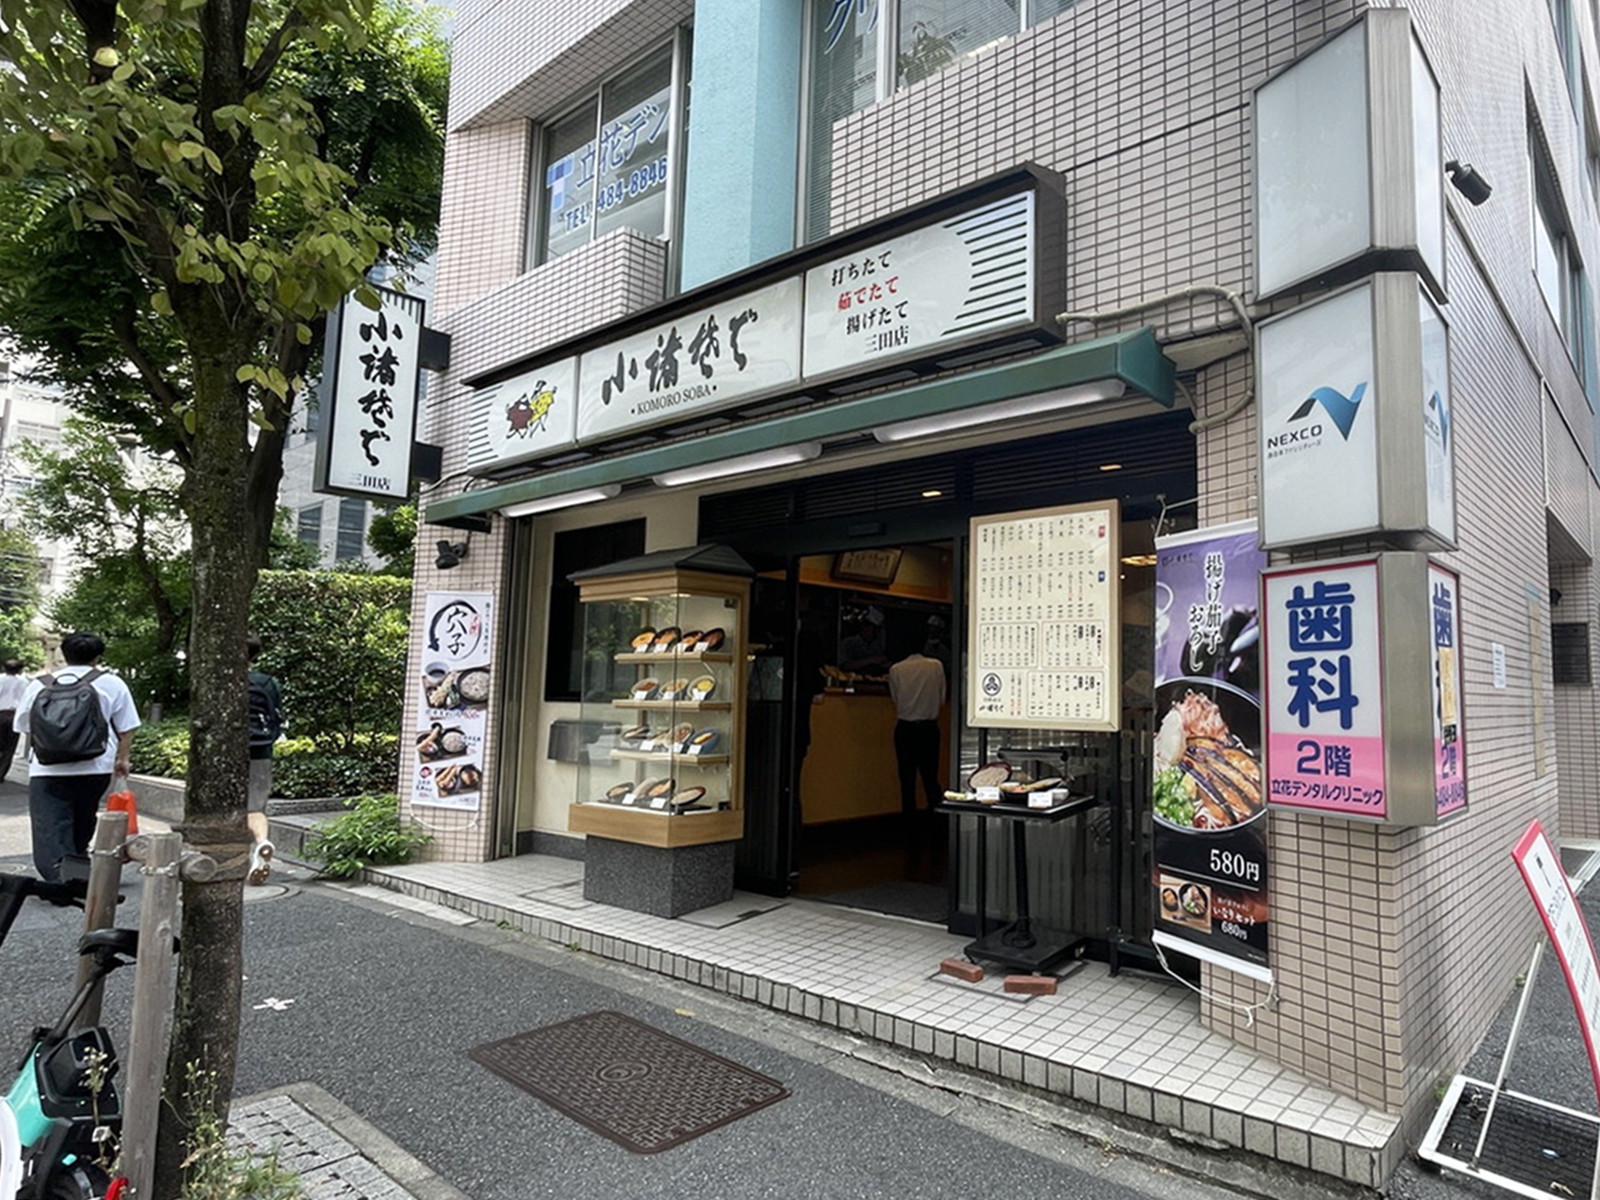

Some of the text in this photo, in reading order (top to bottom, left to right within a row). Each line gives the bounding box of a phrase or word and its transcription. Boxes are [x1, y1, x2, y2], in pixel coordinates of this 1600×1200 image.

[588, 157, 668, 211] 484-8846
[831, 250, 892, 287] 打ちたて
[837, 276, 899, 311] 茹でたて
[846, 300, 909, 335] 揚げたて
[864, 325, 909, 354] 三田店
[636, 384, 712, 415] KOMORO SOBA
[1268, 425, 1322, 448] NEXCO
[348, 473, 391, 490] 三田店
[1205, 552, 1224, 655] 揚げ茄子
[446, 607, 468, 656] 穴子
[1189, 605, 1205, 672] おろし
[1285, 581, 1359, 730] 歯科
[1296, 740, 1351, 777] 2階
[1271, 778, 1383, 806] 立花デンタルクリニック
[1210, 849, 1260, 882] 580円
